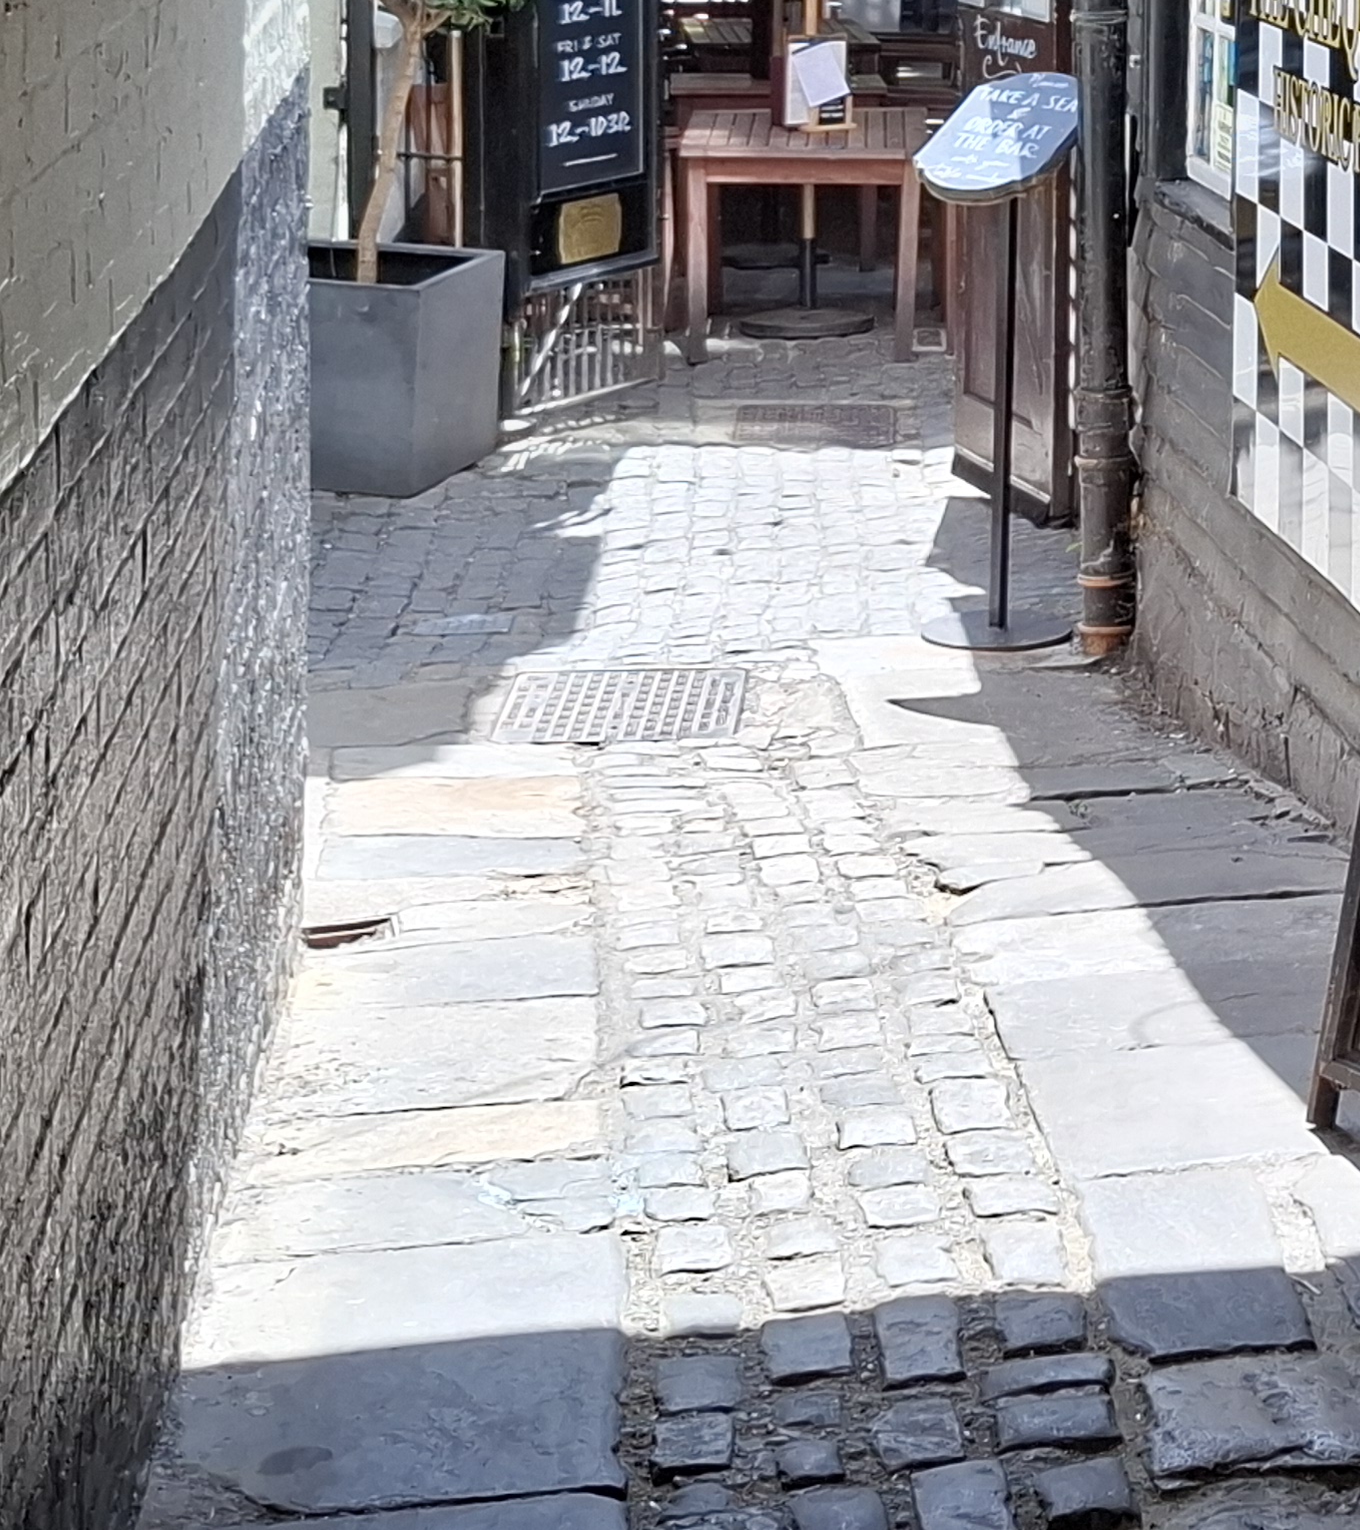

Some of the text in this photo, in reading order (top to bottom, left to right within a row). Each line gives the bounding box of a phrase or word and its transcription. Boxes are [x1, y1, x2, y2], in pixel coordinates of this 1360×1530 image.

[557, 39, 578, 54] FRI
[596, 32, 622, 49] SAT
[1041, 95, 1078, 114] SEA
[1273, 65, 1352, 172] HISTORIC
[1022, 124, 1052, 140] AT
[953, 132, 1040, 159] THE BAR
